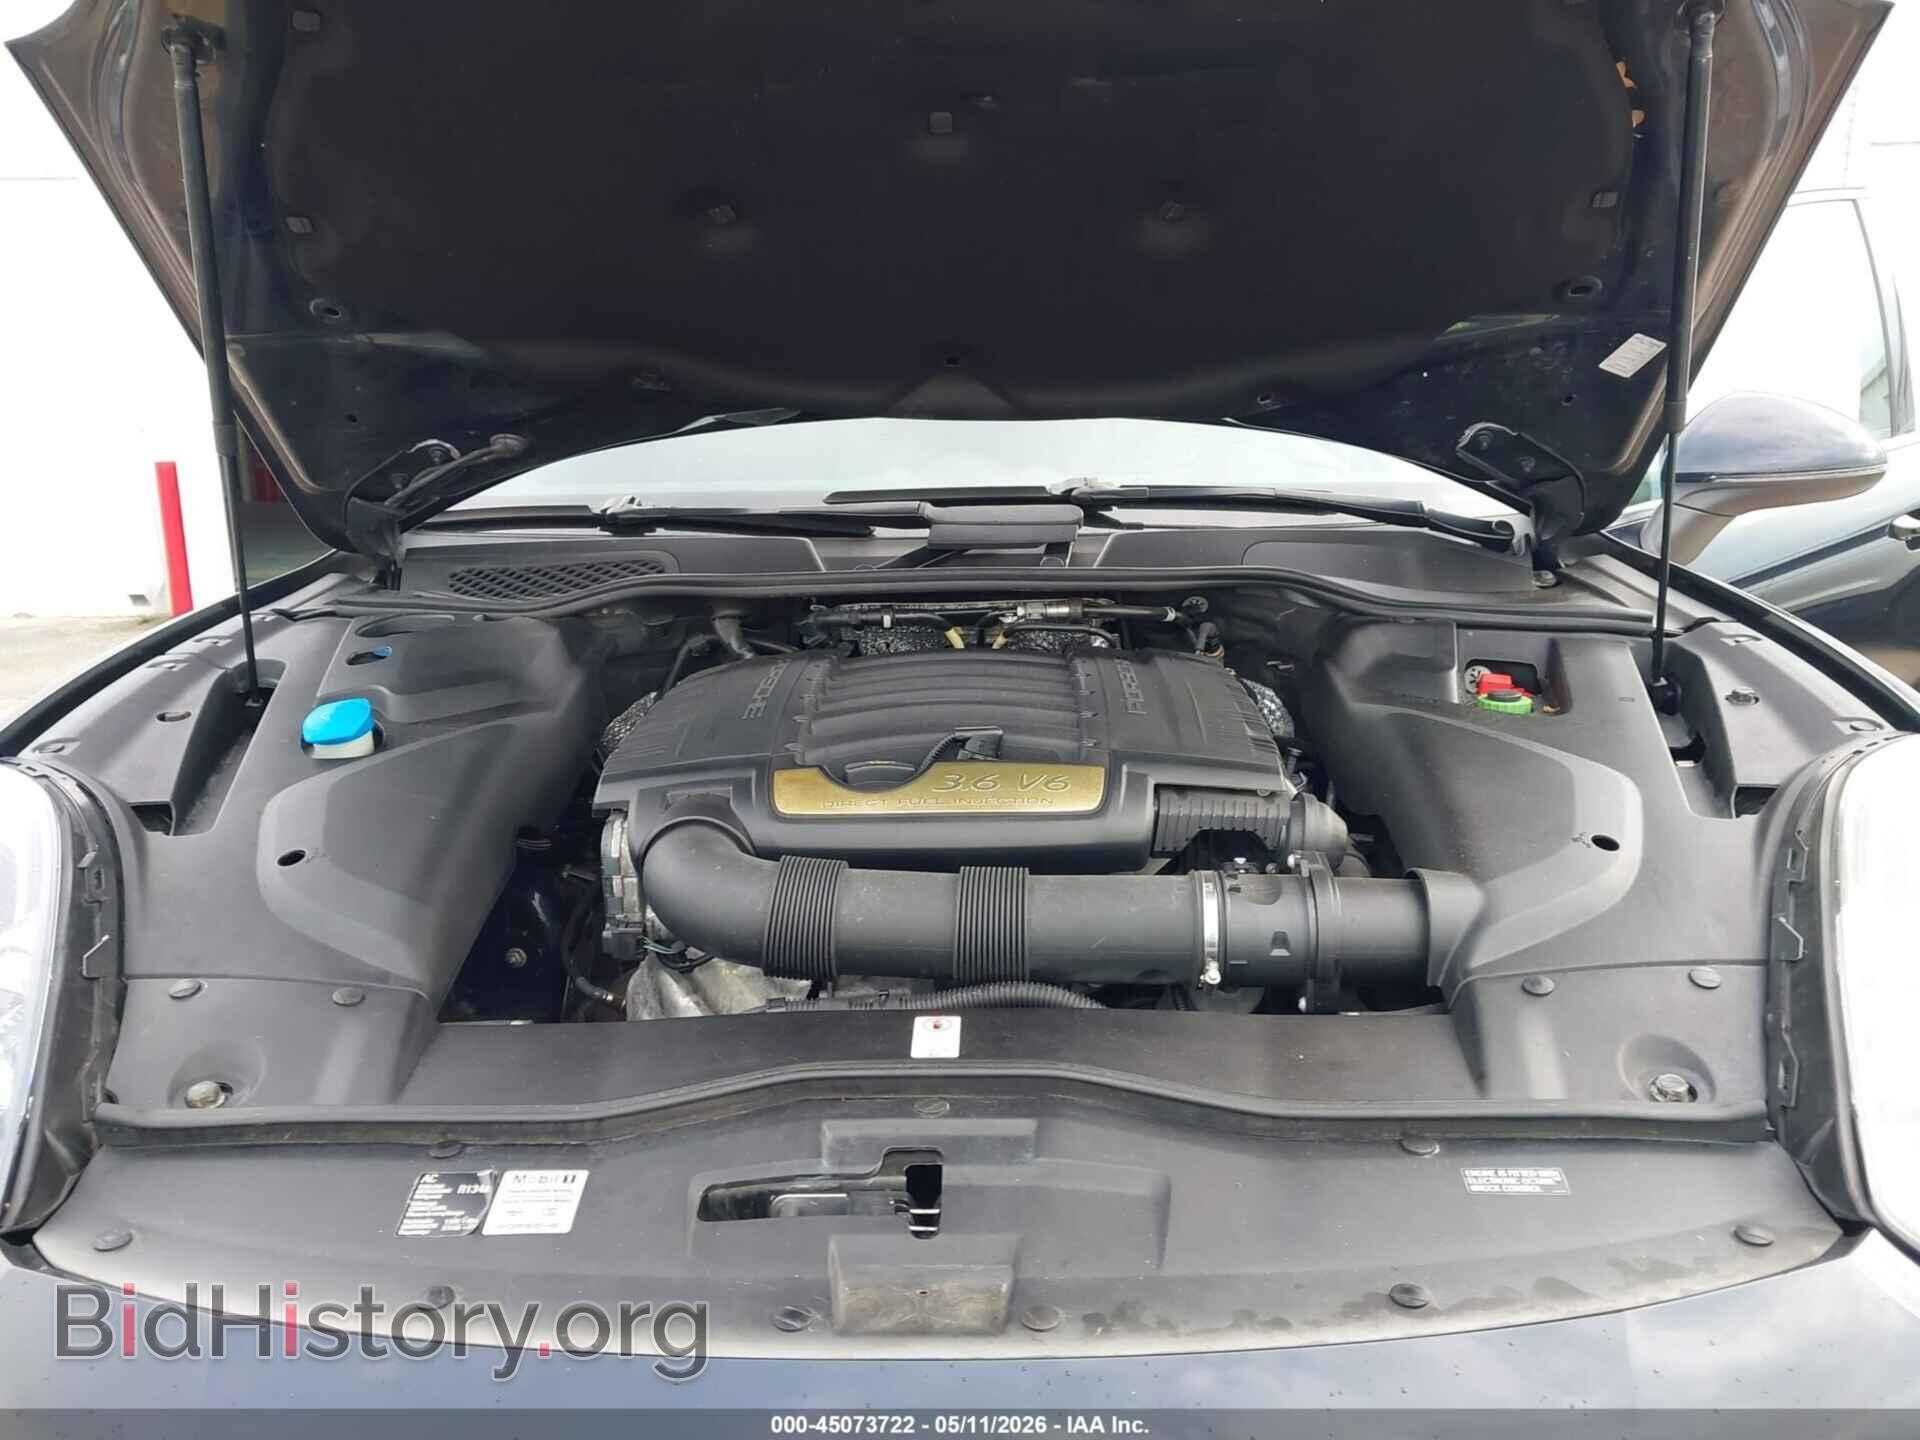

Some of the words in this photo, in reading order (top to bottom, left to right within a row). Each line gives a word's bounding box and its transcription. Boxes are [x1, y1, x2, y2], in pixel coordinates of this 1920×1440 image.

[931, 773, 1000, 792] 3.6
[1017, 773, 1070, 792] V6
[420, 1174, 439, 1184] AC
